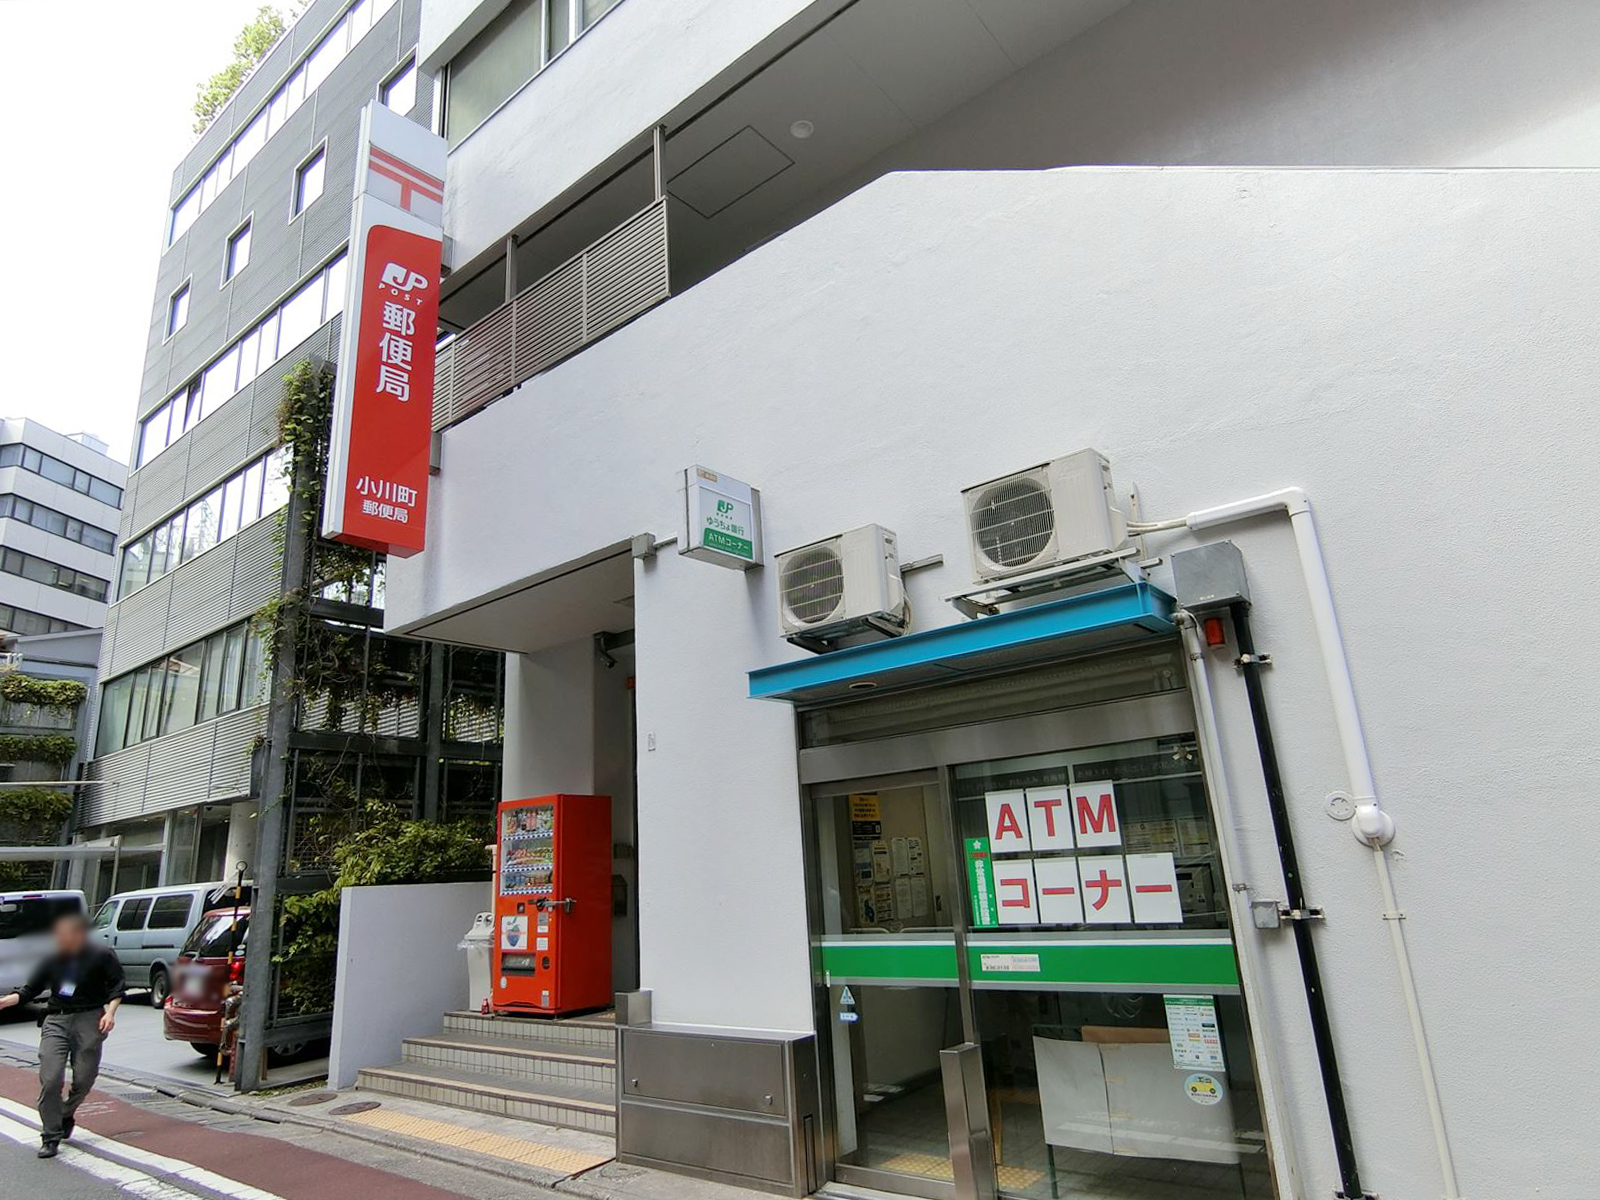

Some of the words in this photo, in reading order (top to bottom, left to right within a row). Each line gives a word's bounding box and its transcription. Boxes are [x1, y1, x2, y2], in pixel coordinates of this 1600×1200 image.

[378, 283, 423, 305] POST
[376, 301, 416, 401] 郵便局
[356, 476, 418, 507] 小川町
[362, 499, 408, 523] 郵便局
[706, 516, 745, 536] ゆうちょ銀行
[994, 793, 1116, 840] ATM
[1000, 869, 1173, 911] コーナー
